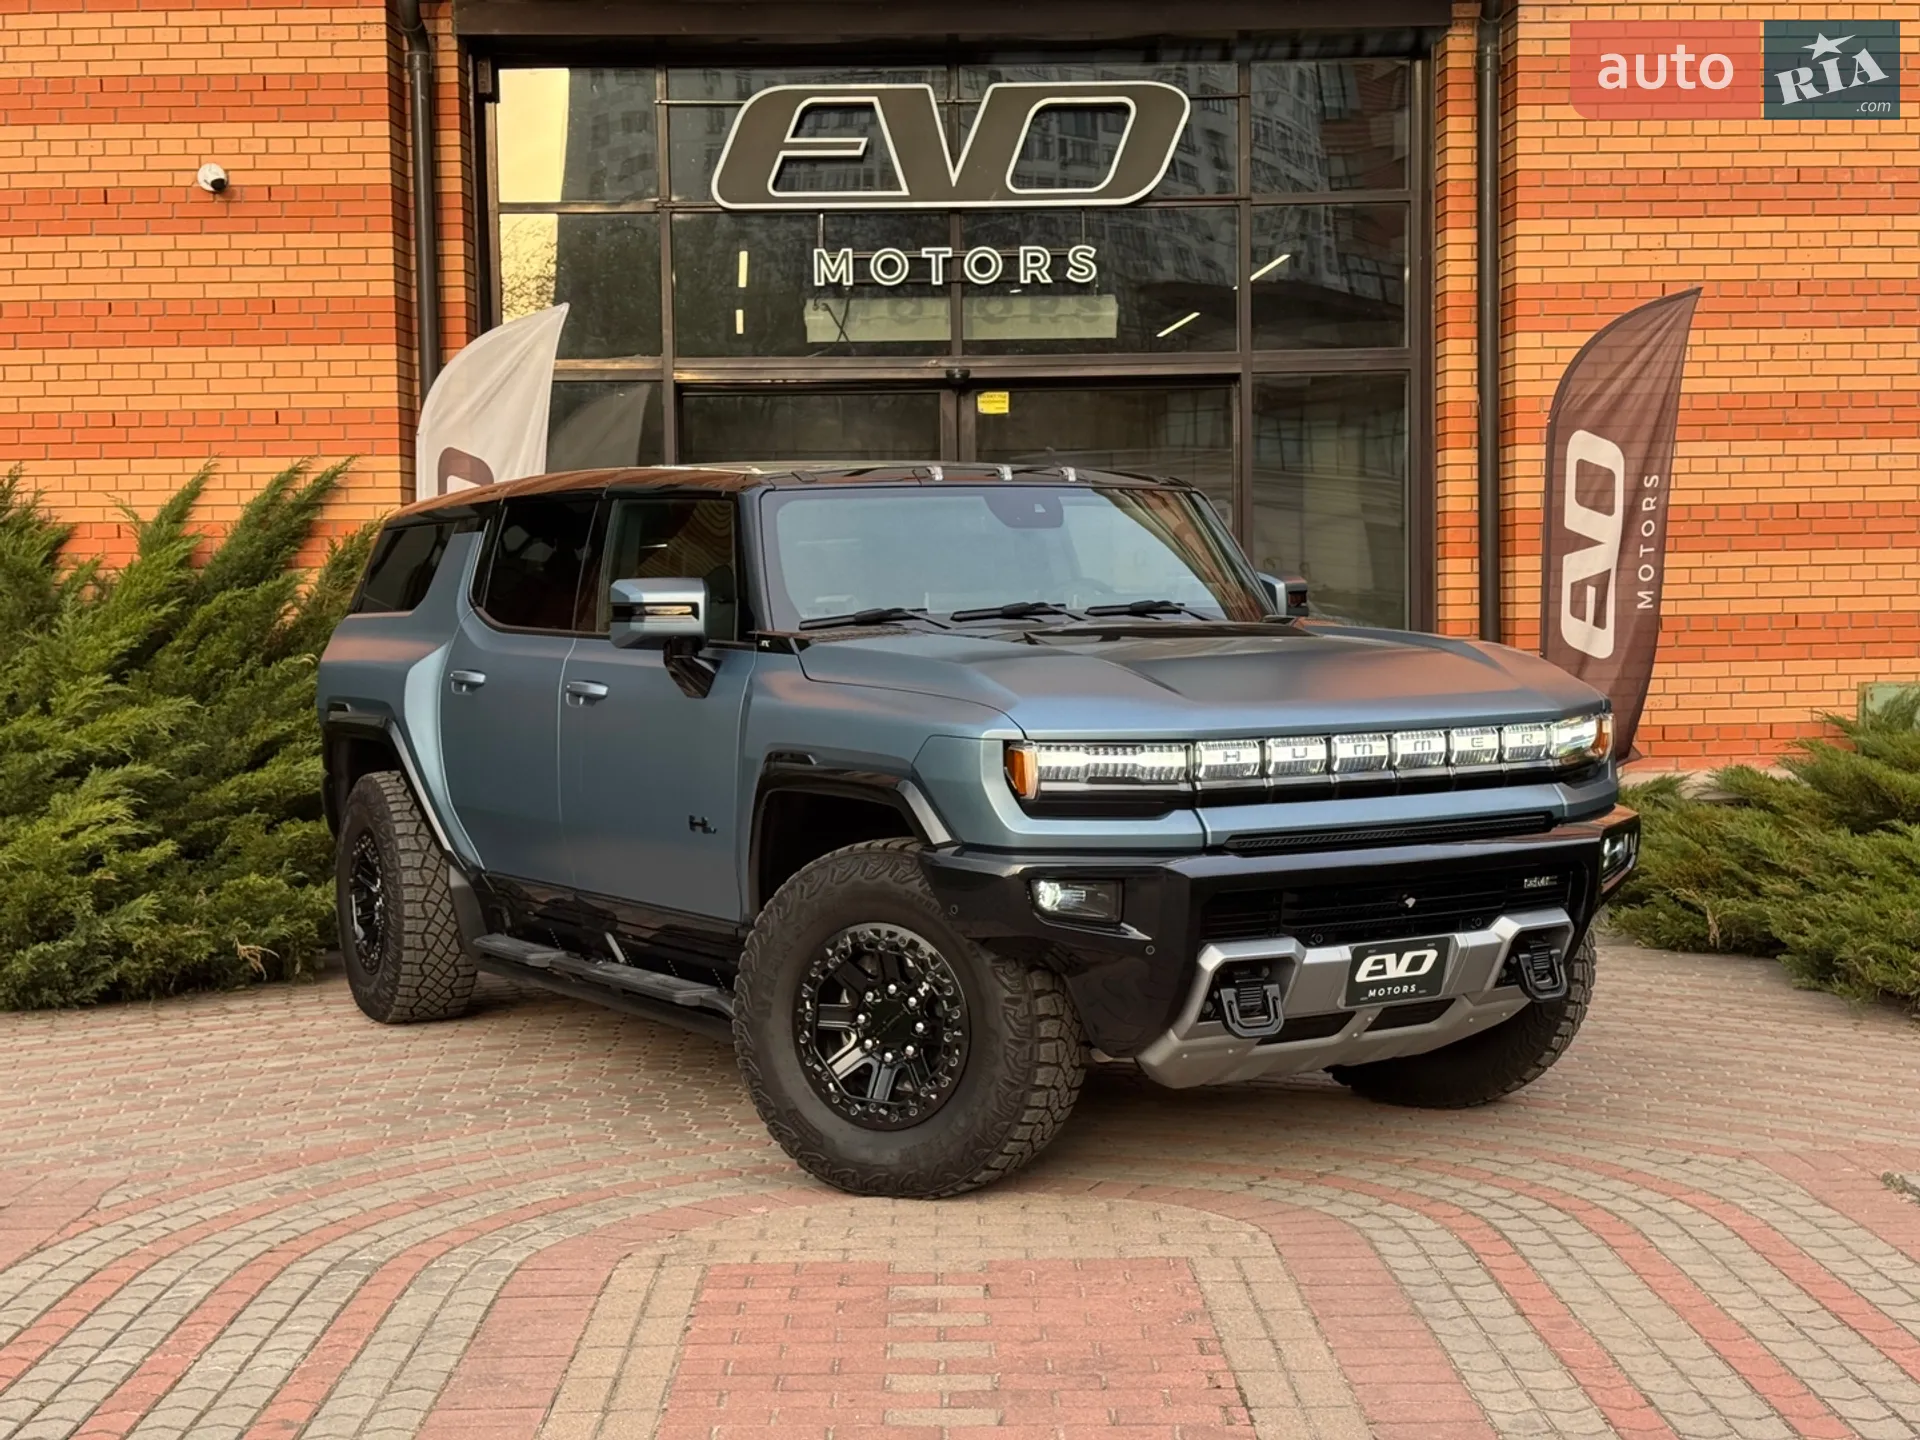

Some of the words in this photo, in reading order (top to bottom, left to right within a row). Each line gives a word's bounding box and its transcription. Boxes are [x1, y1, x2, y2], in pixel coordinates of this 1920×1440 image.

[711, 81, 1191, 209] EVO
[812, 244, 1098, 286] MOTORS
[1560, 429, 1625, 659] EVO
[1636, 474, 1659, 610] MOTORS
[1222, 732, 1535, 763] HUMMER
[1355, 949, 1438, 982] EVO
[1367, 984, 1416, 998] MOTORS
